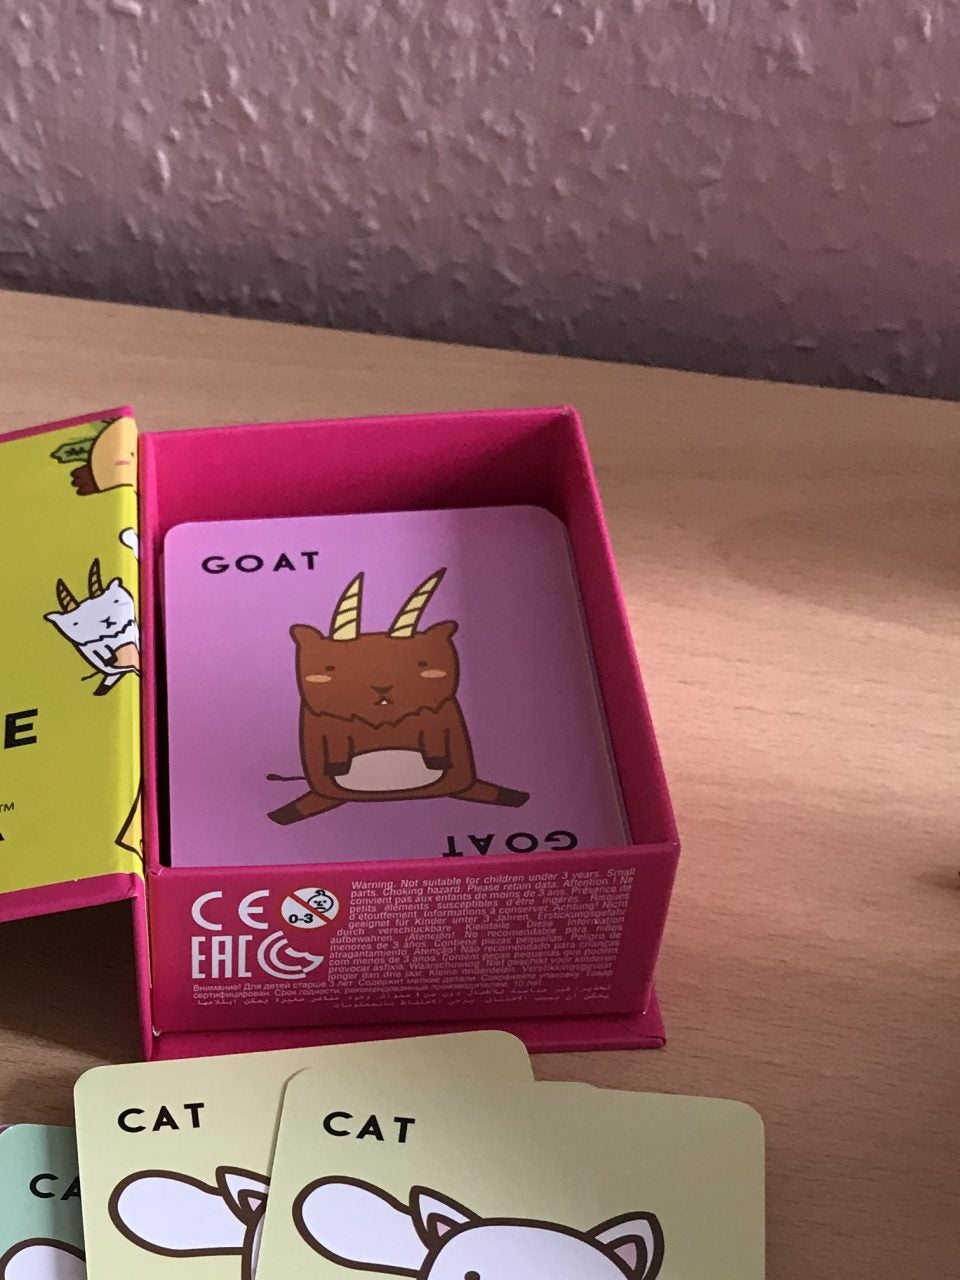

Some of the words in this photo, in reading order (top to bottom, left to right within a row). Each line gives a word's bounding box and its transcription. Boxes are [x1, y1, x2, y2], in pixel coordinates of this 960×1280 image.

[202, 551, 319, 574] GOAT
[443, 831, 577, 857] GOAT
[118, 1103, 204, 1132] CAT
[323, 1112, 415, 1143] CAT
